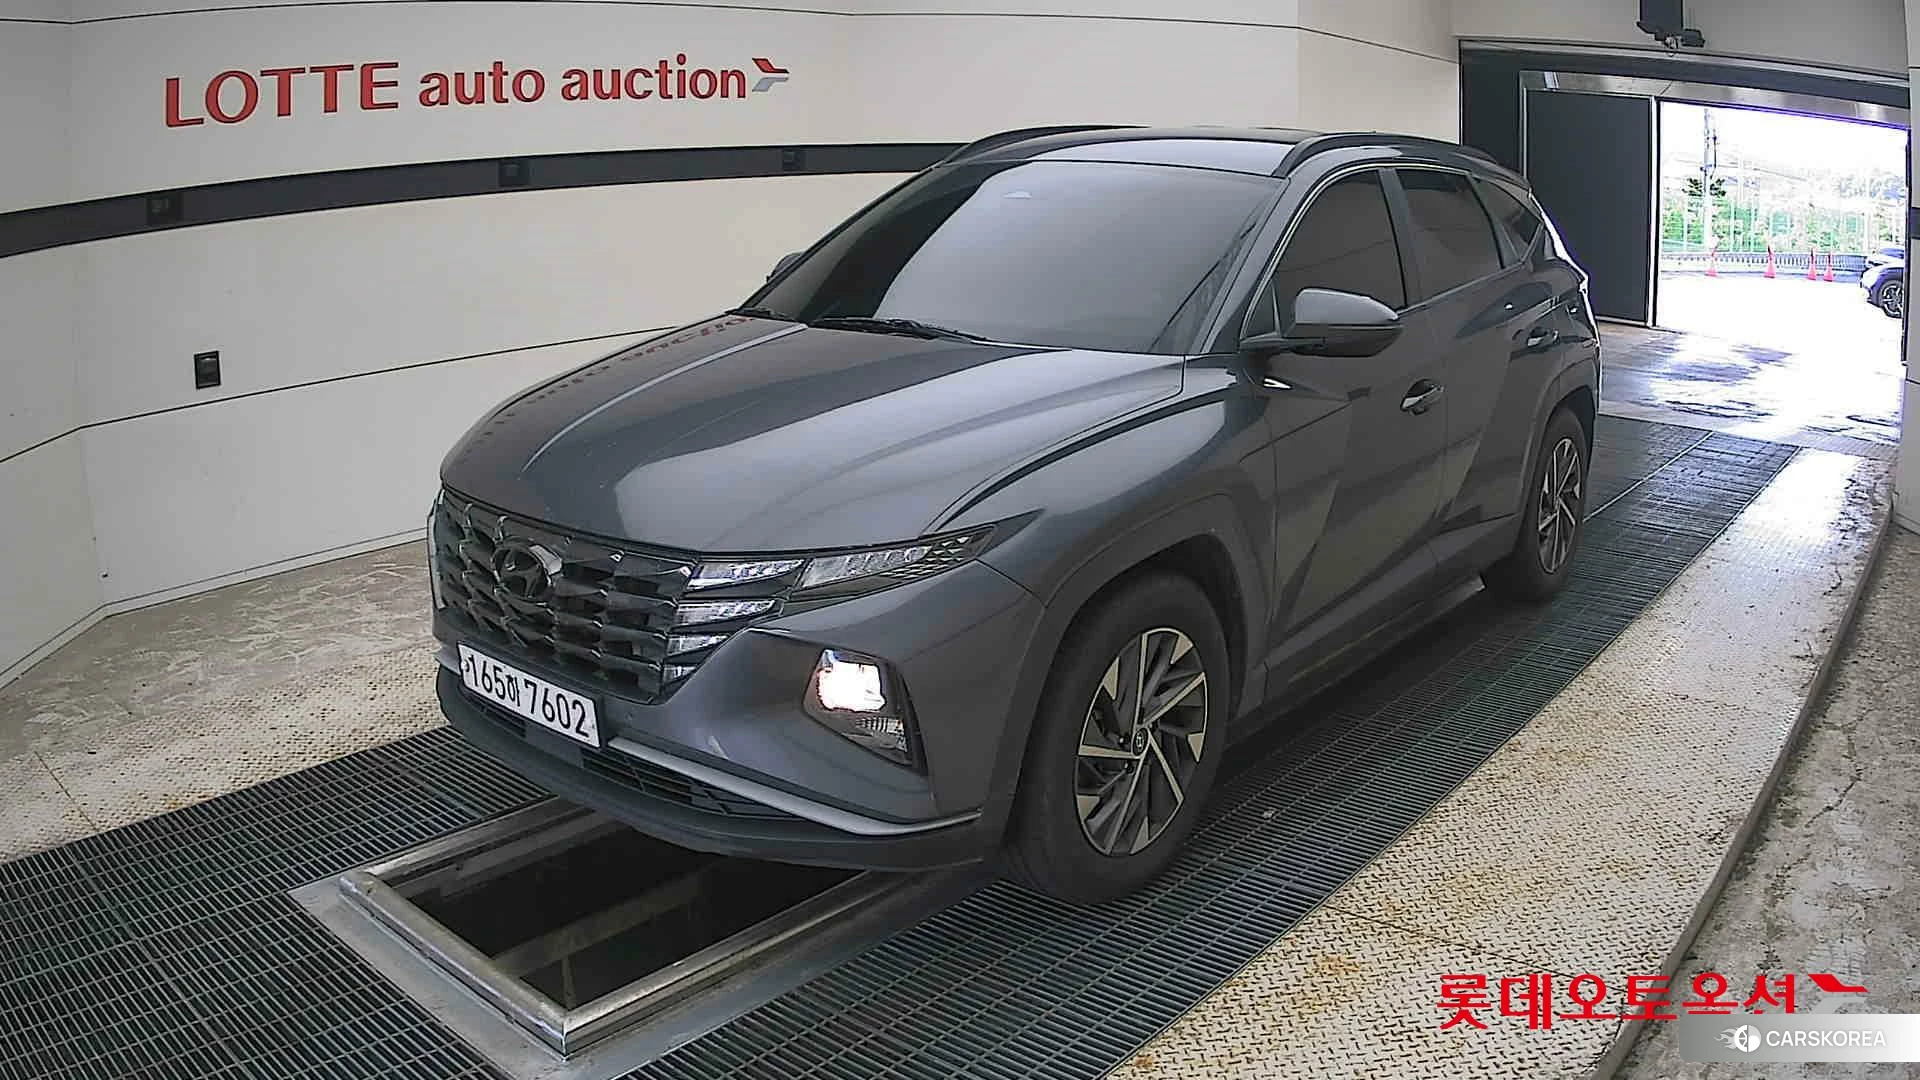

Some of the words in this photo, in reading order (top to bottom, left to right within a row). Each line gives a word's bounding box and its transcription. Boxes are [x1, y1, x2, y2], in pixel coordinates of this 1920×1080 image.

[164, 61, 400, 128] LOTTE
[418, 60, 546, 107] auto
[560, 53, 747, 101] auction
